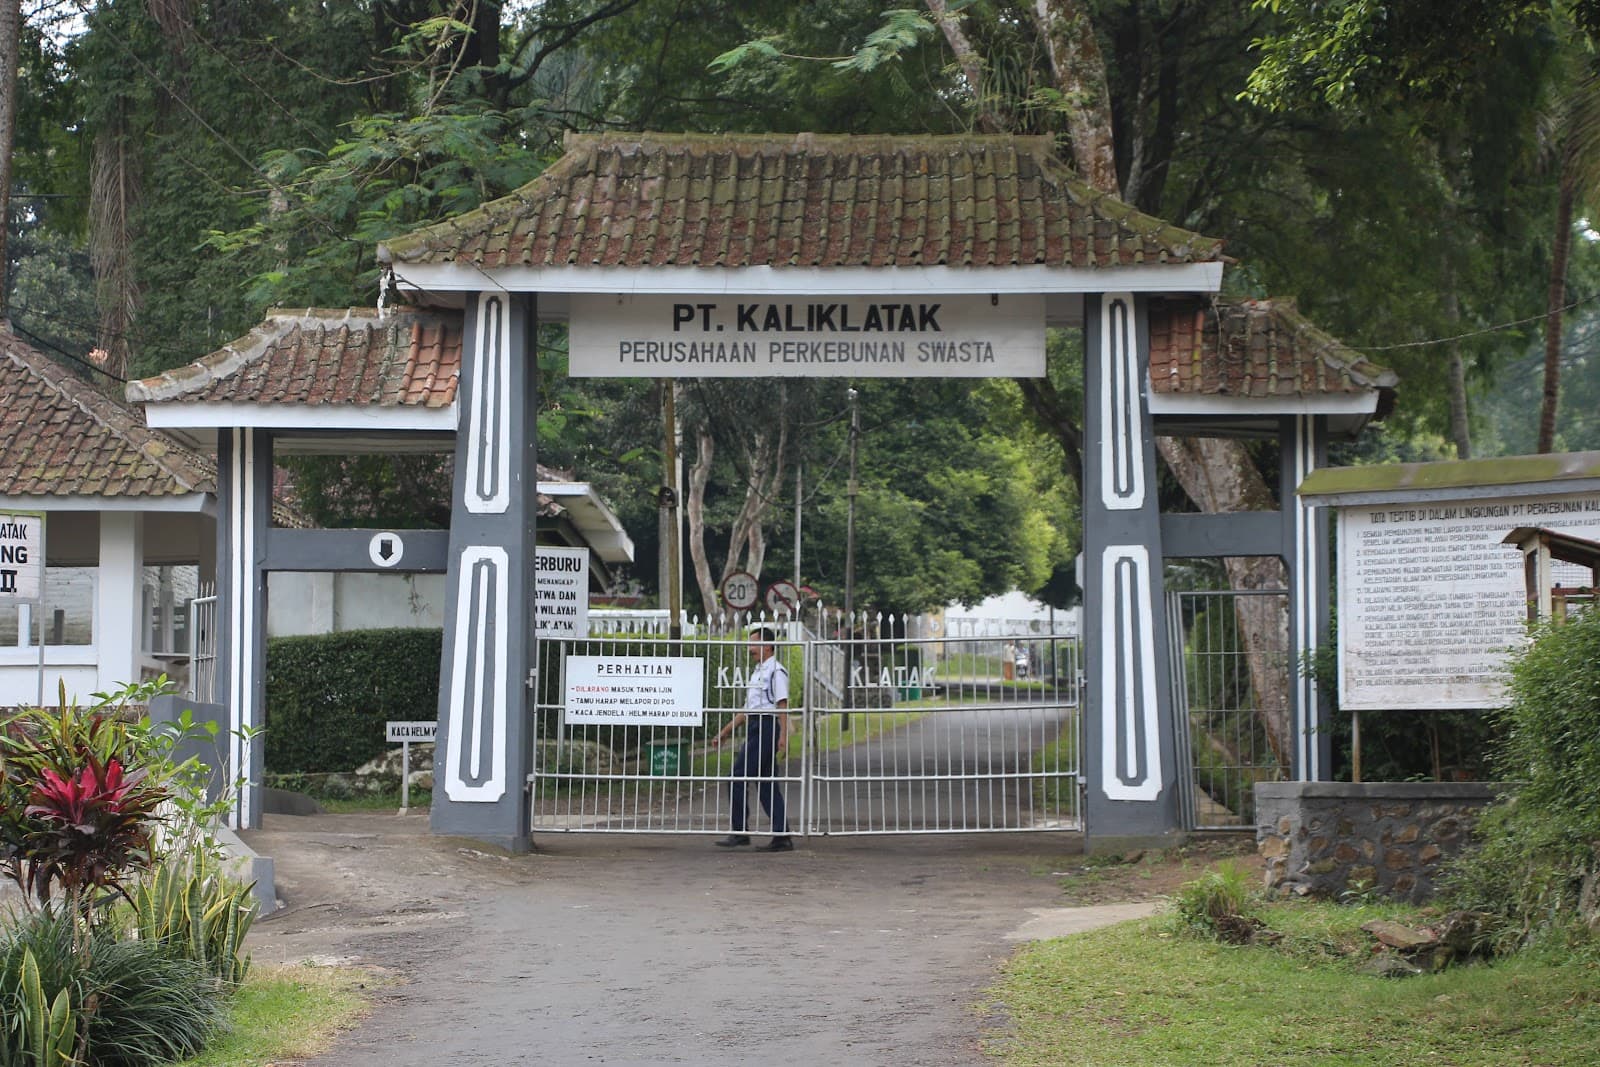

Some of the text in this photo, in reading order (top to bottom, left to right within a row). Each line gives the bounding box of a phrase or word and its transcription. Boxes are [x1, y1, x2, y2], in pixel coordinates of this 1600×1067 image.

[673, 304, 942, 332] PT. KALIKLATAK
[619, 341, 995, 363] PERUSAHAAN PERKEBUNAN SWASTA
[1369, 512, 1385, 523] TATA
[1429, 507, 1457, 520] DALAM
[1459, 504, 1509, 518] LINGKUNGAN
[1527, 501, 1582, 515] PERKEBUNAN
[560, 591, 576, 601] DAN
[729, 584, 745, 600] 20
[541, 605, 576, 615] WILAYAH
[597, 664, 672, 675] PERHATIAN
[851, 666, 936, 688] KLATAK
[596, 697, 618, 705] HARAP
[595, 709, 625, 717] JENDELA
[649, 710, 670, 718] HARAP
[391, 726, 409, 736] KACA
[412, 726, 430, 736] HELM
